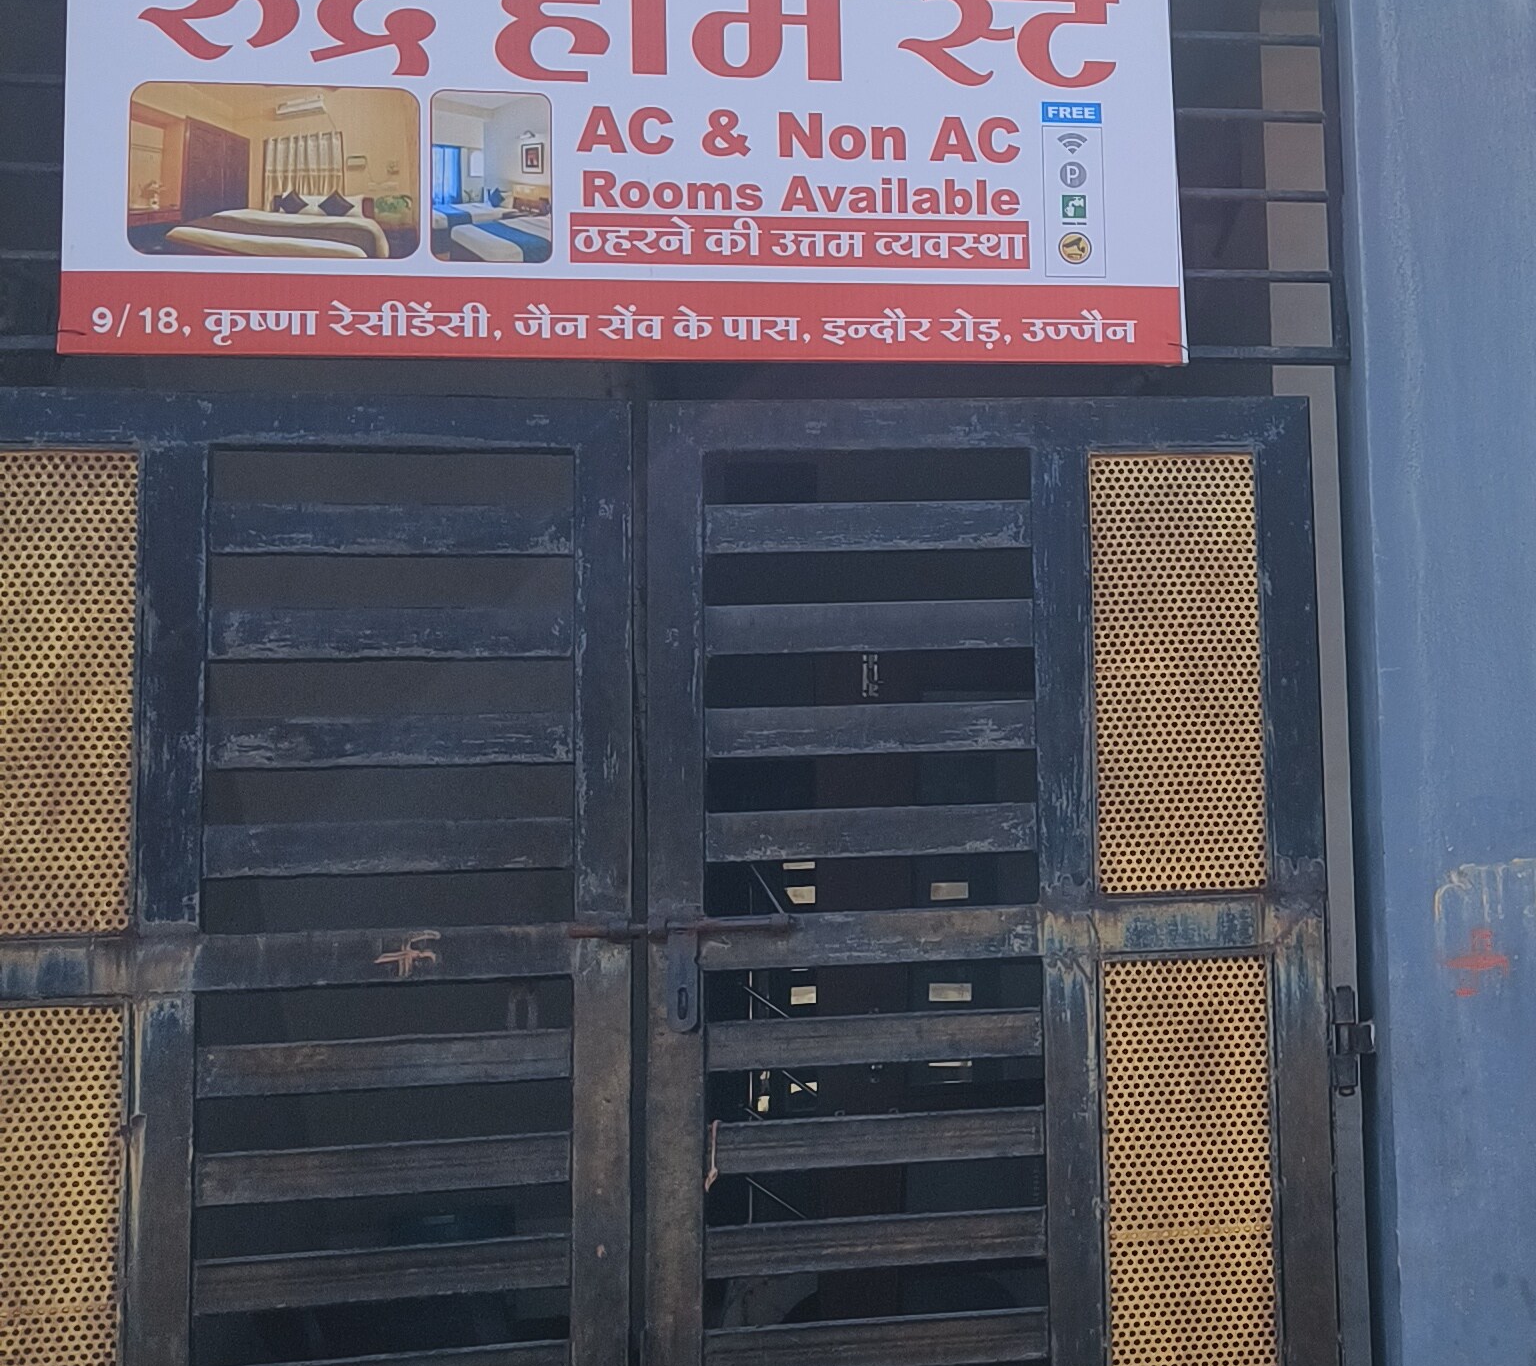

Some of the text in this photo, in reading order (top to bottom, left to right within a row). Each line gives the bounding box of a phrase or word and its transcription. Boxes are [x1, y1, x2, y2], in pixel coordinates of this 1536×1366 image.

[576, 105, 1021, 163] AC & Non AC
[1047, 105, 1096, 120] FREE
[581, 170, 1021, 216] Rooms Available
[573, 216, 1028, 261] ठहरने की उत्तम व्यवस्था
[92, 304, 192, 337] 9/18,
[204, 308, 319, 346] कृष्णा
[328, 300, 502, 341] रेसीडेंसी,
[513, 304, 589, 340] जैन
[673, 305, 713, 341] के
[722, 315, 810, 344] पास,
[822, 308, 932, 345] इन्दौर
[1022, 310, 1138, 343] उज्जैन
